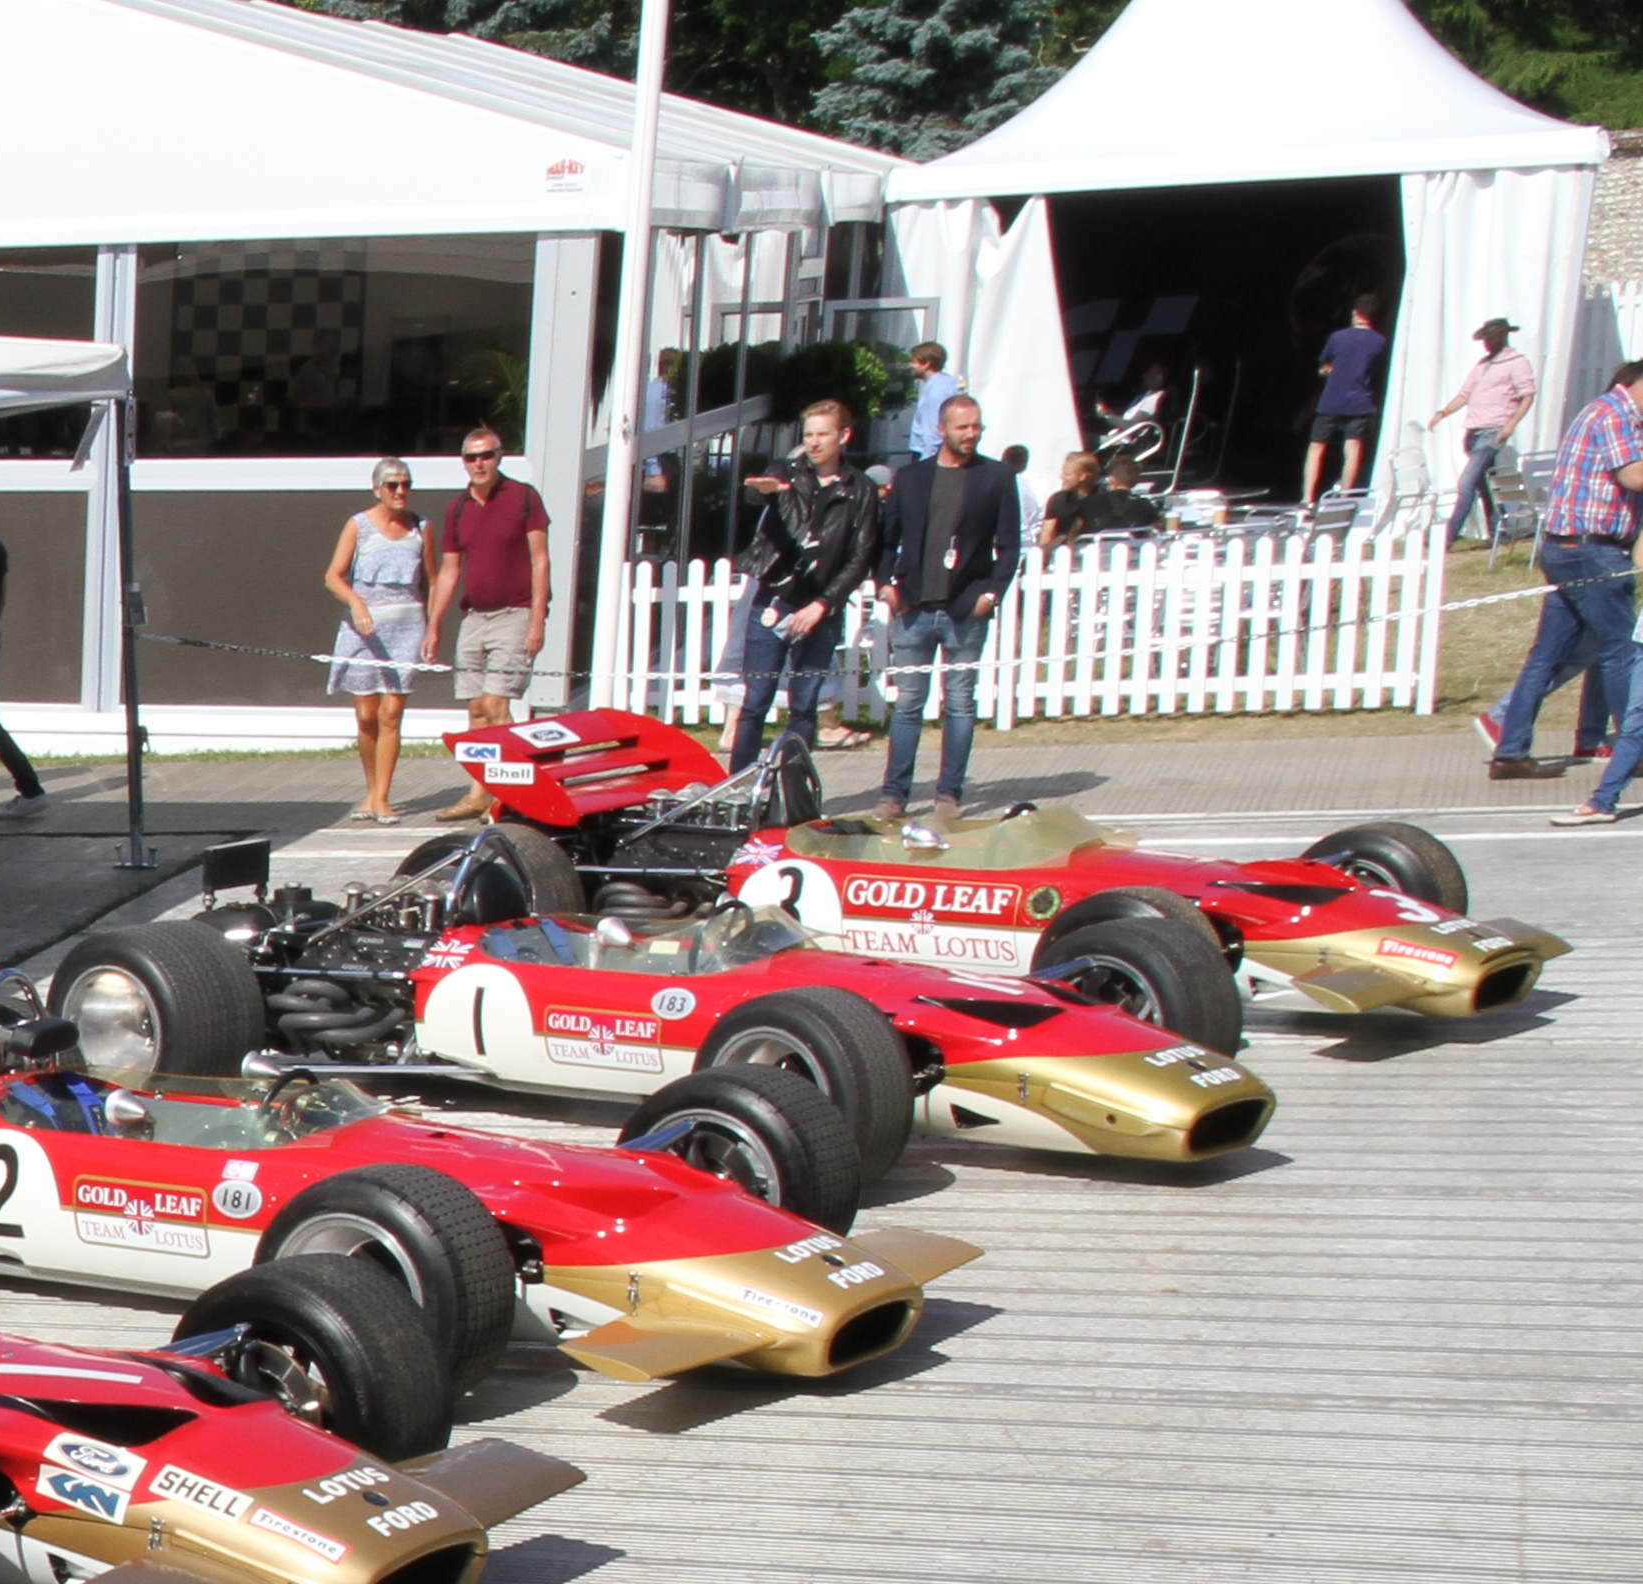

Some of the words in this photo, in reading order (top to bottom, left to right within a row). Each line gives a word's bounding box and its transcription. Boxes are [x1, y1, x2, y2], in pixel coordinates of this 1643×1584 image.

[487, 767, 531, 779] Shell
[846, 879, 926, 910] GOLD
[933, 885, 1014, 915] LEAF
[1368, 889, 1440, 923] 3
[846, 928, 919, 955] TEAM
[934, 935, 1017, 962] LOTUS
[1382, 940, 1455, 965] Firestone
[658, 995, 687, 1013] 183
[473, 986, 486, 1056] 1
[547, 1013, 592, 1032] GOLD
[615, 1019, 657, 1038] LEAF
[551, 1044, 591, 1060] TEAM
[614, 1050, 659, 1067] LOTUS
[1143, 1045, 1207, 1067] LOTUS
[1188, 1067, 1242, 1088] FORD
[77, 1185, 128, 1208] GOLD
[154, 1193, 202, 1216] LEAF
[222, 1188, 252, 1211] 181
[81, 1220, 126, 1241] TEAM
[154, 1230, 204, 1251] LOTUS
[773, 1235, 843, 1264] LOTUS
[827, 1261, 886, 1290] FORD
[70, 1445, 116, 1476] Ford
[158, 1470, 240, 1518] SHELL
[301, 1466, 390, 1504] LOTUS
[259, 1512, 338, 1554] Firestone
[365, 1500, 439, 1537] FORD
